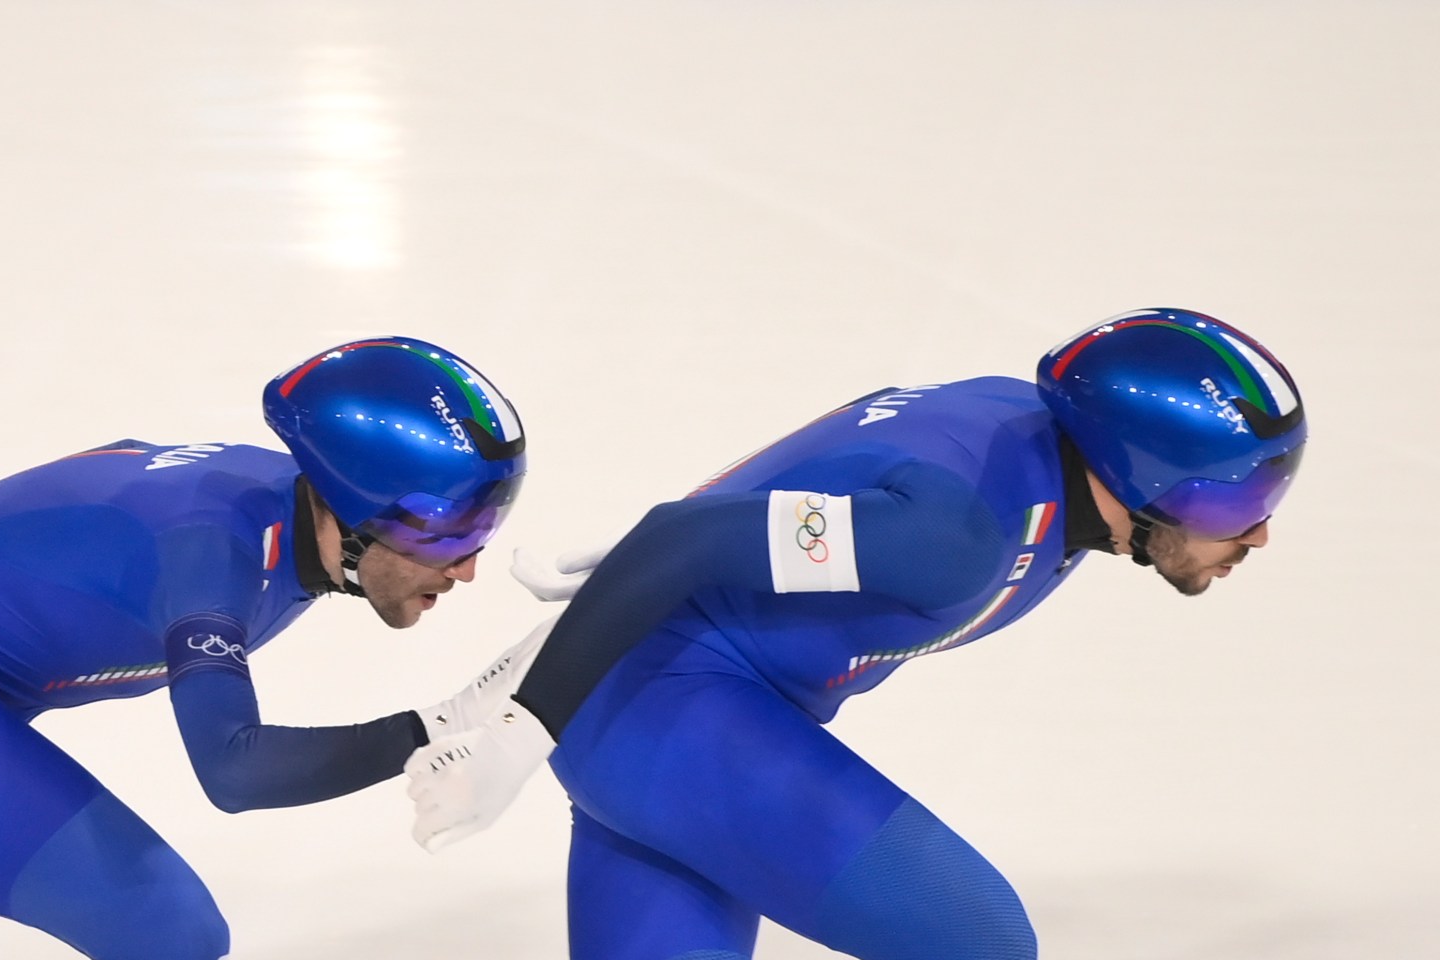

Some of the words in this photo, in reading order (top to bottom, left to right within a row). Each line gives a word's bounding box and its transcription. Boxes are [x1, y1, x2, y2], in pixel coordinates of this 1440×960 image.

[1200, 377, 1249, 433] RUDY
[431, 395, 474, 453] RUDY
[145, 444, 225, 470] ALIA
[477, 656, 512, 688] ITALY
[429, 745, 472, 773] ITALY
